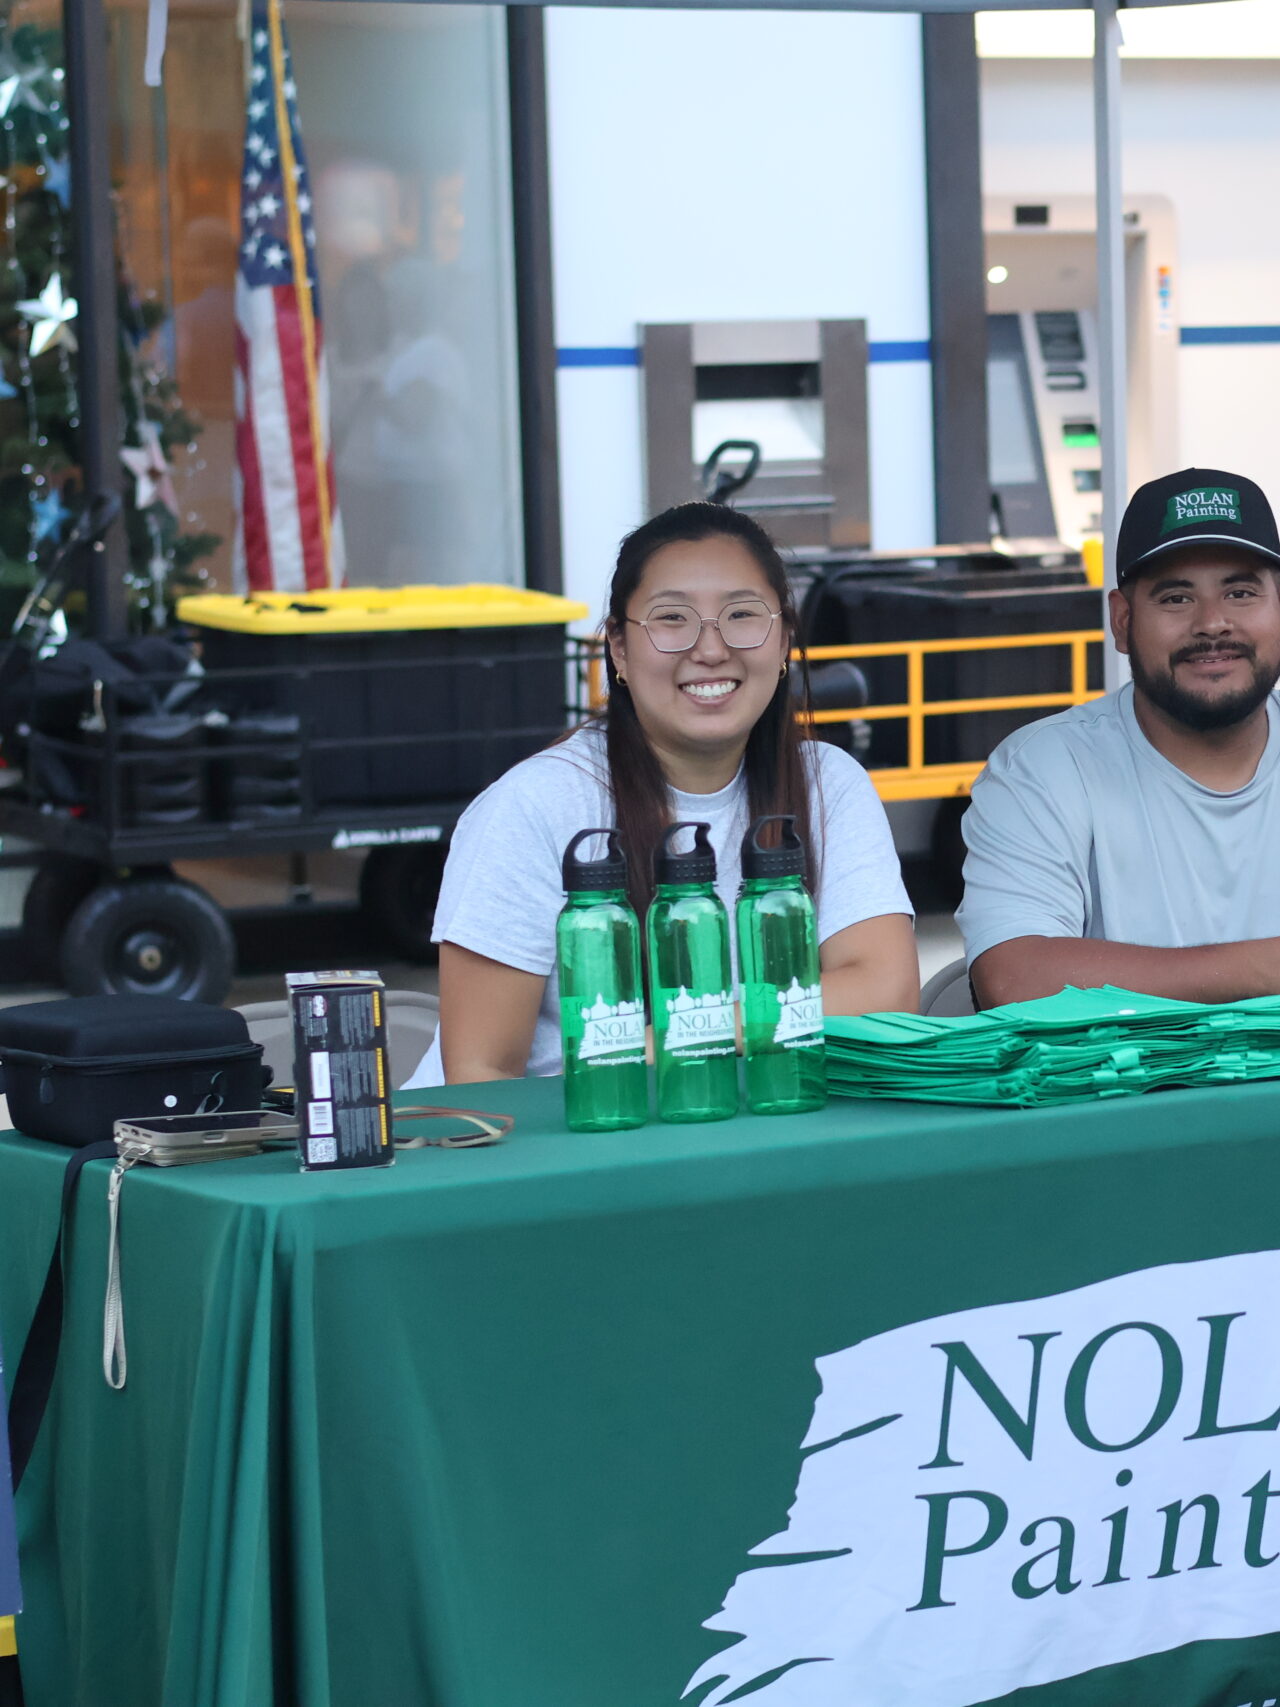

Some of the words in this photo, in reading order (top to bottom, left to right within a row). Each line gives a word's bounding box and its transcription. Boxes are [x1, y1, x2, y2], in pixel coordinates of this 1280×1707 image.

[1175, 492, 1233, 509] NOLAN
[1176, 504, 1236, 519] Painting
[602, 1039, 614, 1047] THE
